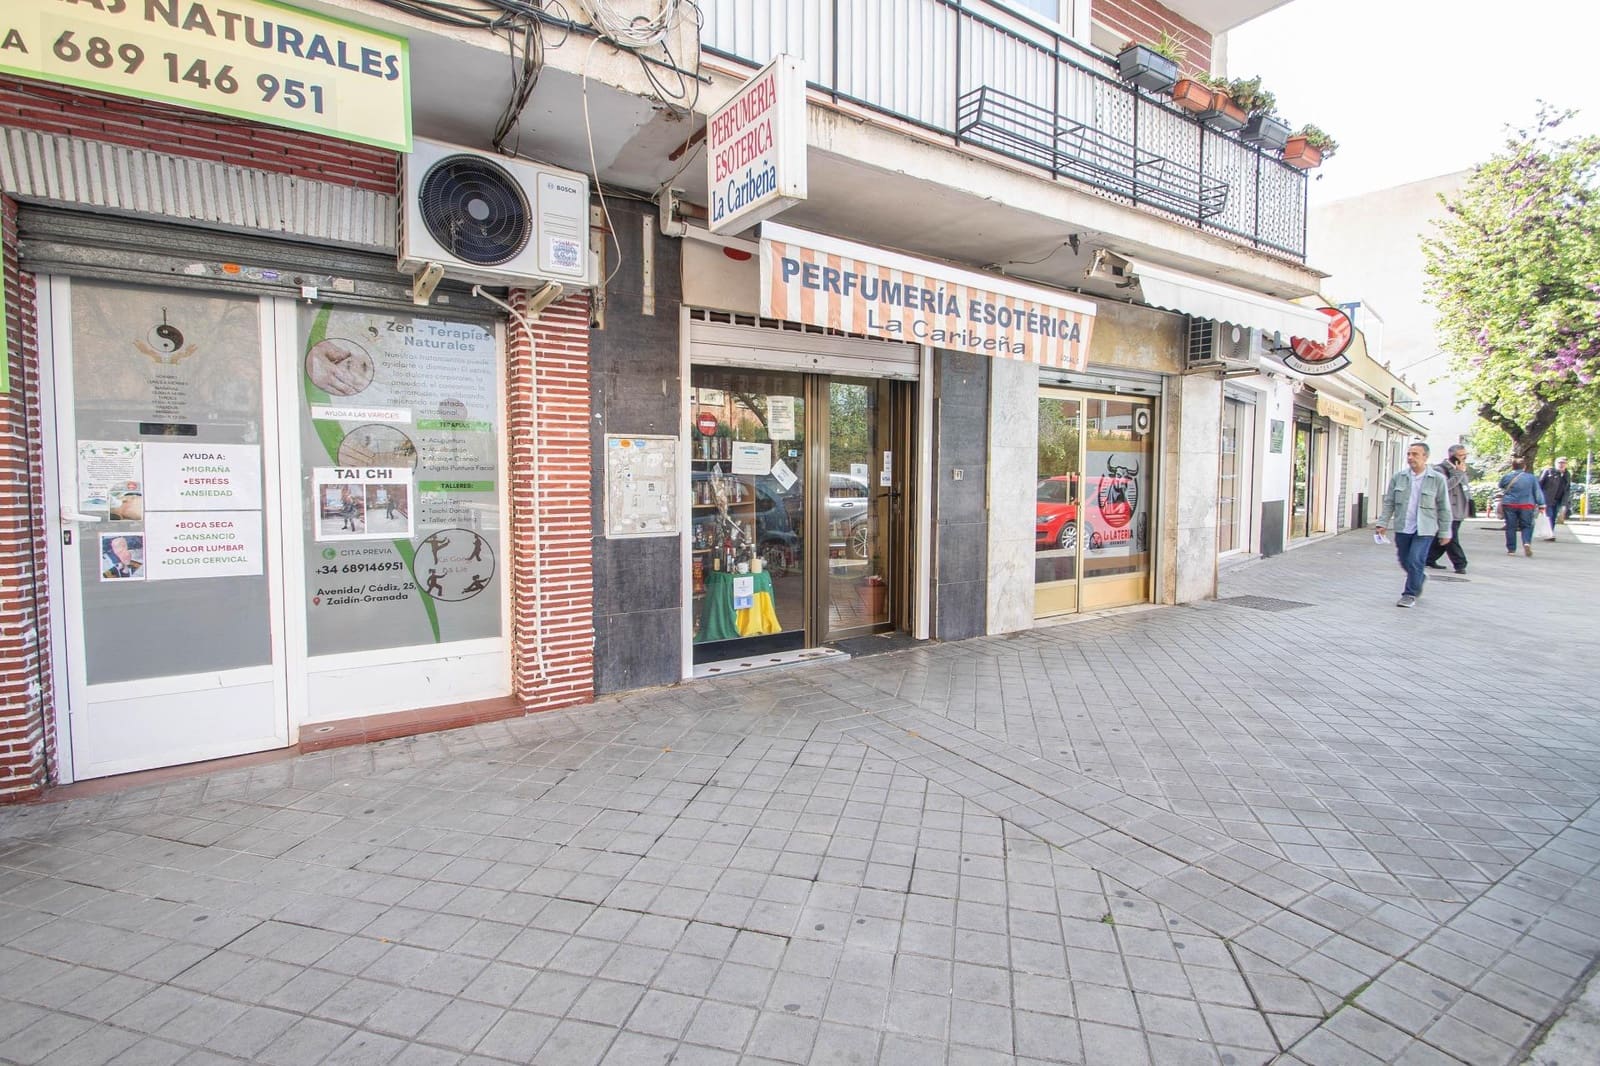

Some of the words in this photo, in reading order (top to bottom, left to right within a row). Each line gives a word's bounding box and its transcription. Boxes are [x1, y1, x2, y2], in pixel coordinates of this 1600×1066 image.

[144, 0, 400, 81] NATURALES
[52, 30, 145, 74] 689
[163, 51, 239, 95] 146
[256, 73, 324, 114] 951
[711, 73, 777, 150] PERFUMERIA
[715, 117, 774, 184] ESOTERICA
[556, 185, 577, 194] BOSCH
[712, 190, 725, 223] La
[727, 159, 777, 215] Caribeña
[781, 256, 962, 318] PERFUMERÍA
[969, 299, 1081, 344] ESOTÉRICA
[386, 321, 414, 333] Zen
[868, 309, 902, 333] La
[912, 319, 1026, 355] Caribeña
[404, 336, 475, 352] Naturales
[182, 453, 213, 461] AYUDA
[213, 453, 226, 461] A:
[186, 464, 231, 473] MIGRAÑA
[335, 469, 360, 479] TAI
[366, 469, 393, 479] CHI
[185, 489, 233, 497] ANSIEDAD
[180, 521, 208, 529] BOCA
[178, 533, 236, 541] CANSANCIO
[171, 545, 204, 553] DOLOR
[205, 544, 245, 552] LUMBAR
[341, 549, 361, 557] CITA
[363, 548, 392, 556] PREVIA
[167, 557, 201, 565] DOLOR
[203, 556, 248, 564] CERVICAL
[315, 564, 338, 575] +34
[342, 562, 404, 574] 689146951
[317, 585, 366, 596] Avenida/
[368, 583, 400, 593] Cádiz,
[402, 582, 417, 591] 25,
[327, 593, 409, 606] Zaidín-Granada
